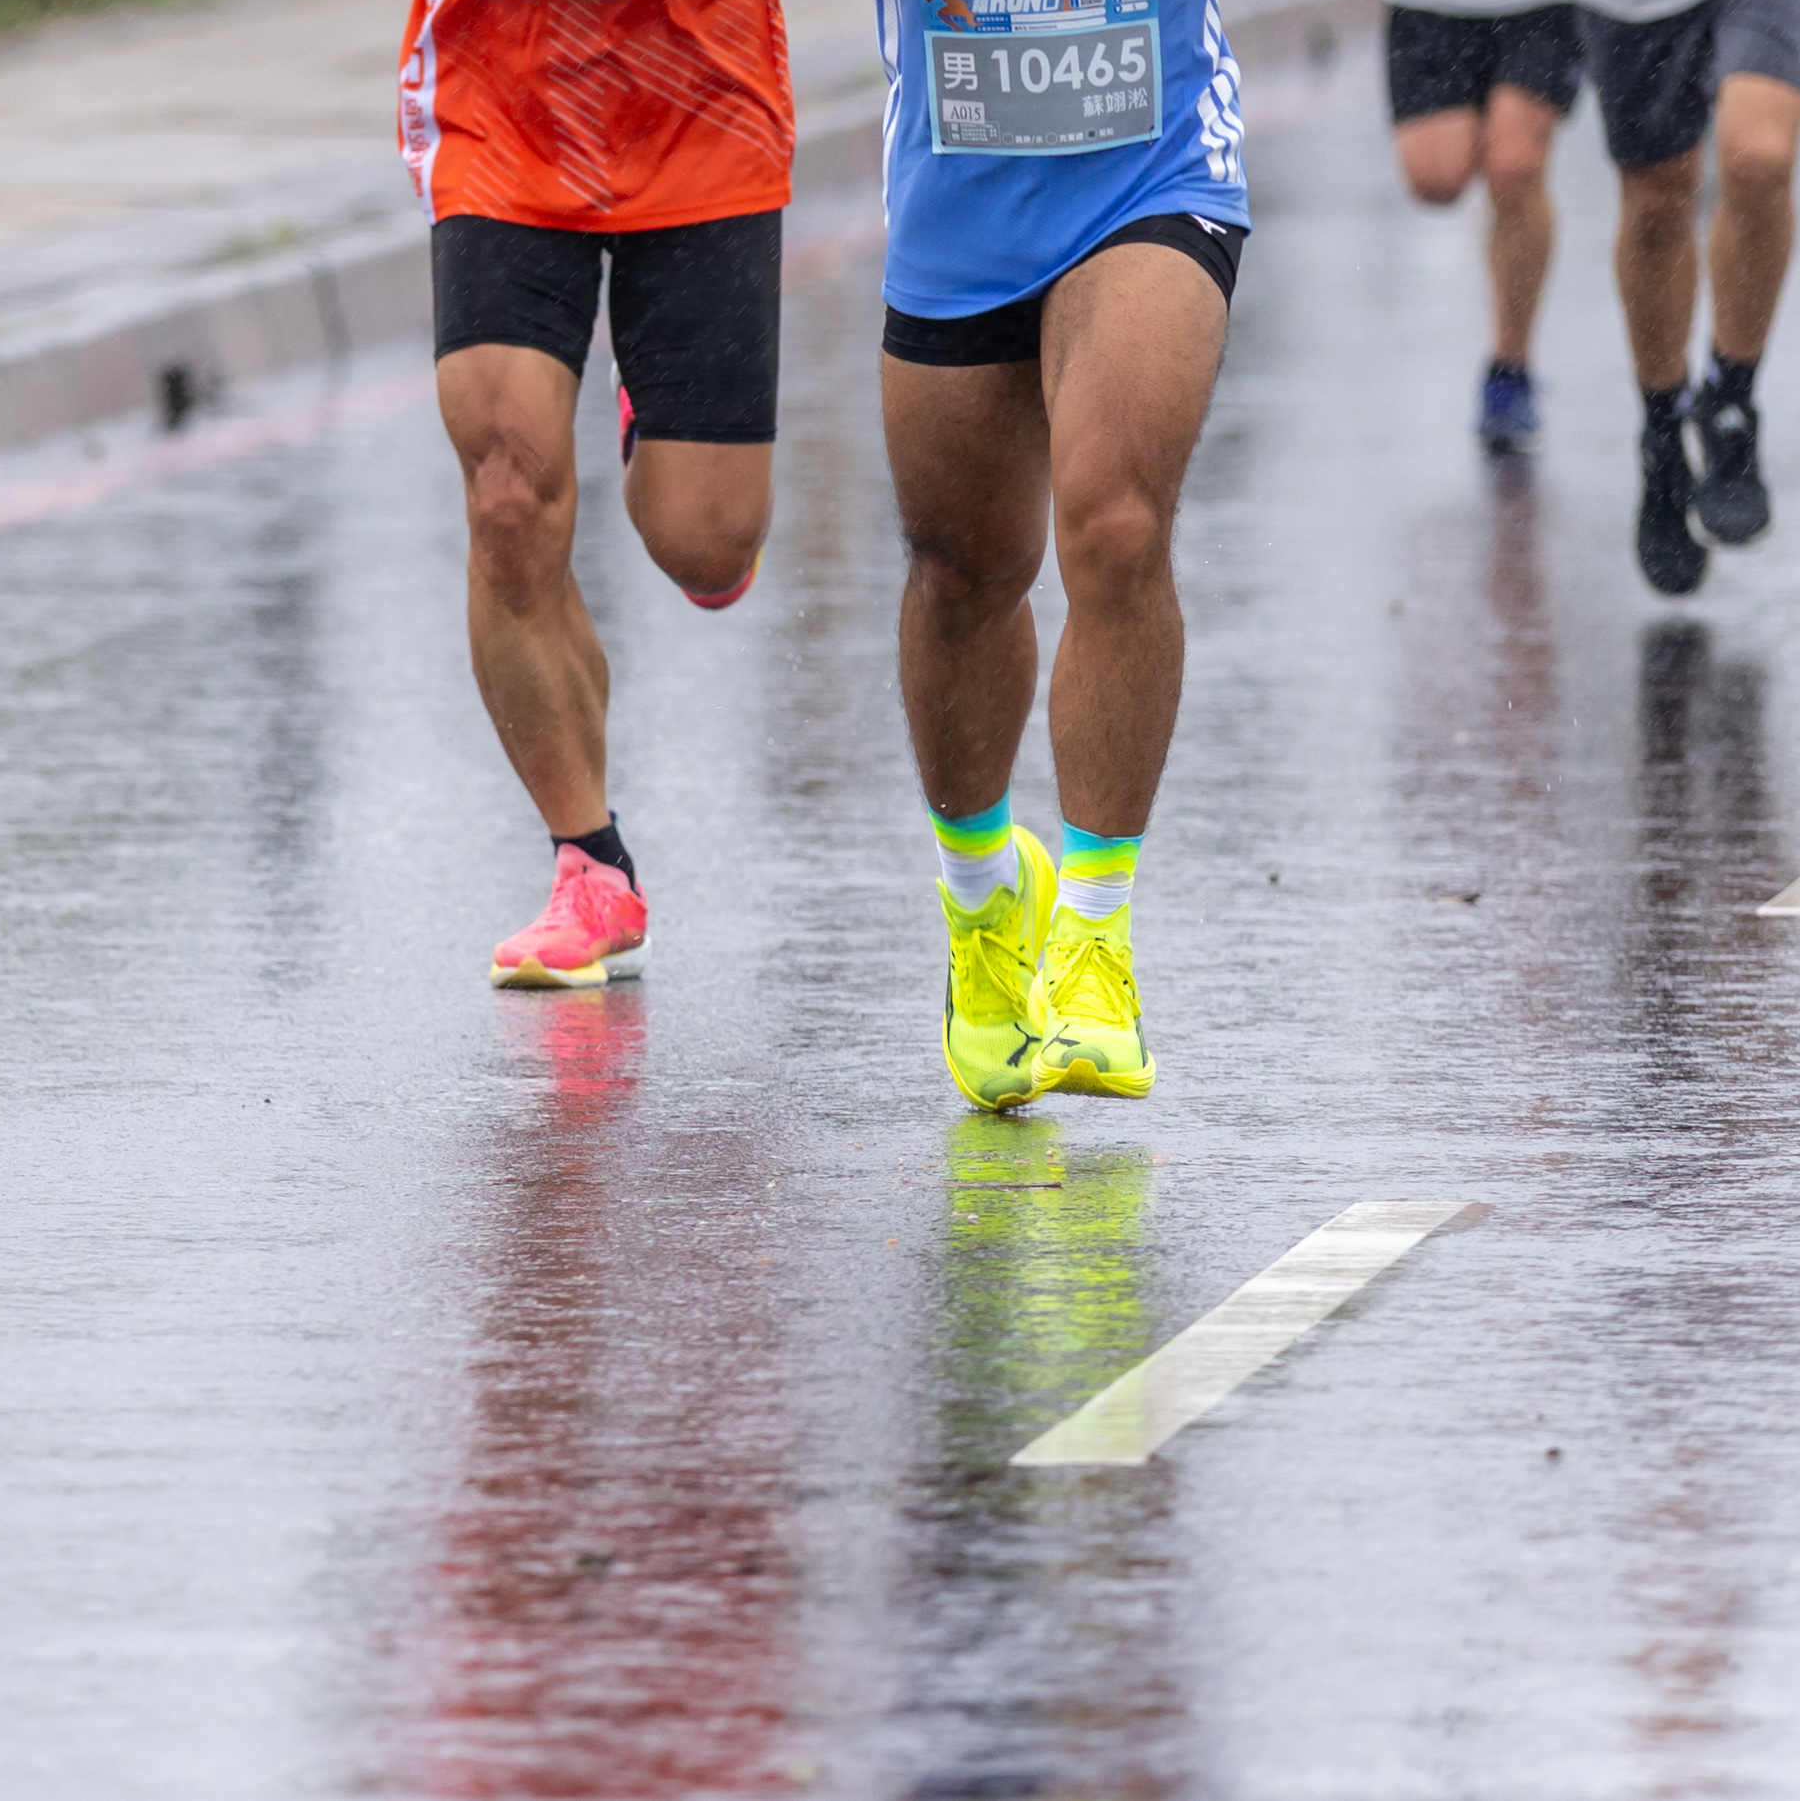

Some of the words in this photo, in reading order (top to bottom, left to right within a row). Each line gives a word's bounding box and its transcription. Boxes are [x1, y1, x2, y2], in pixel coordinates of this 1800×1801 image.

[943, 51, 979, 91] 男
[990, 36, 1147, 94] 10465
[950, 106, 982, 122] A015
